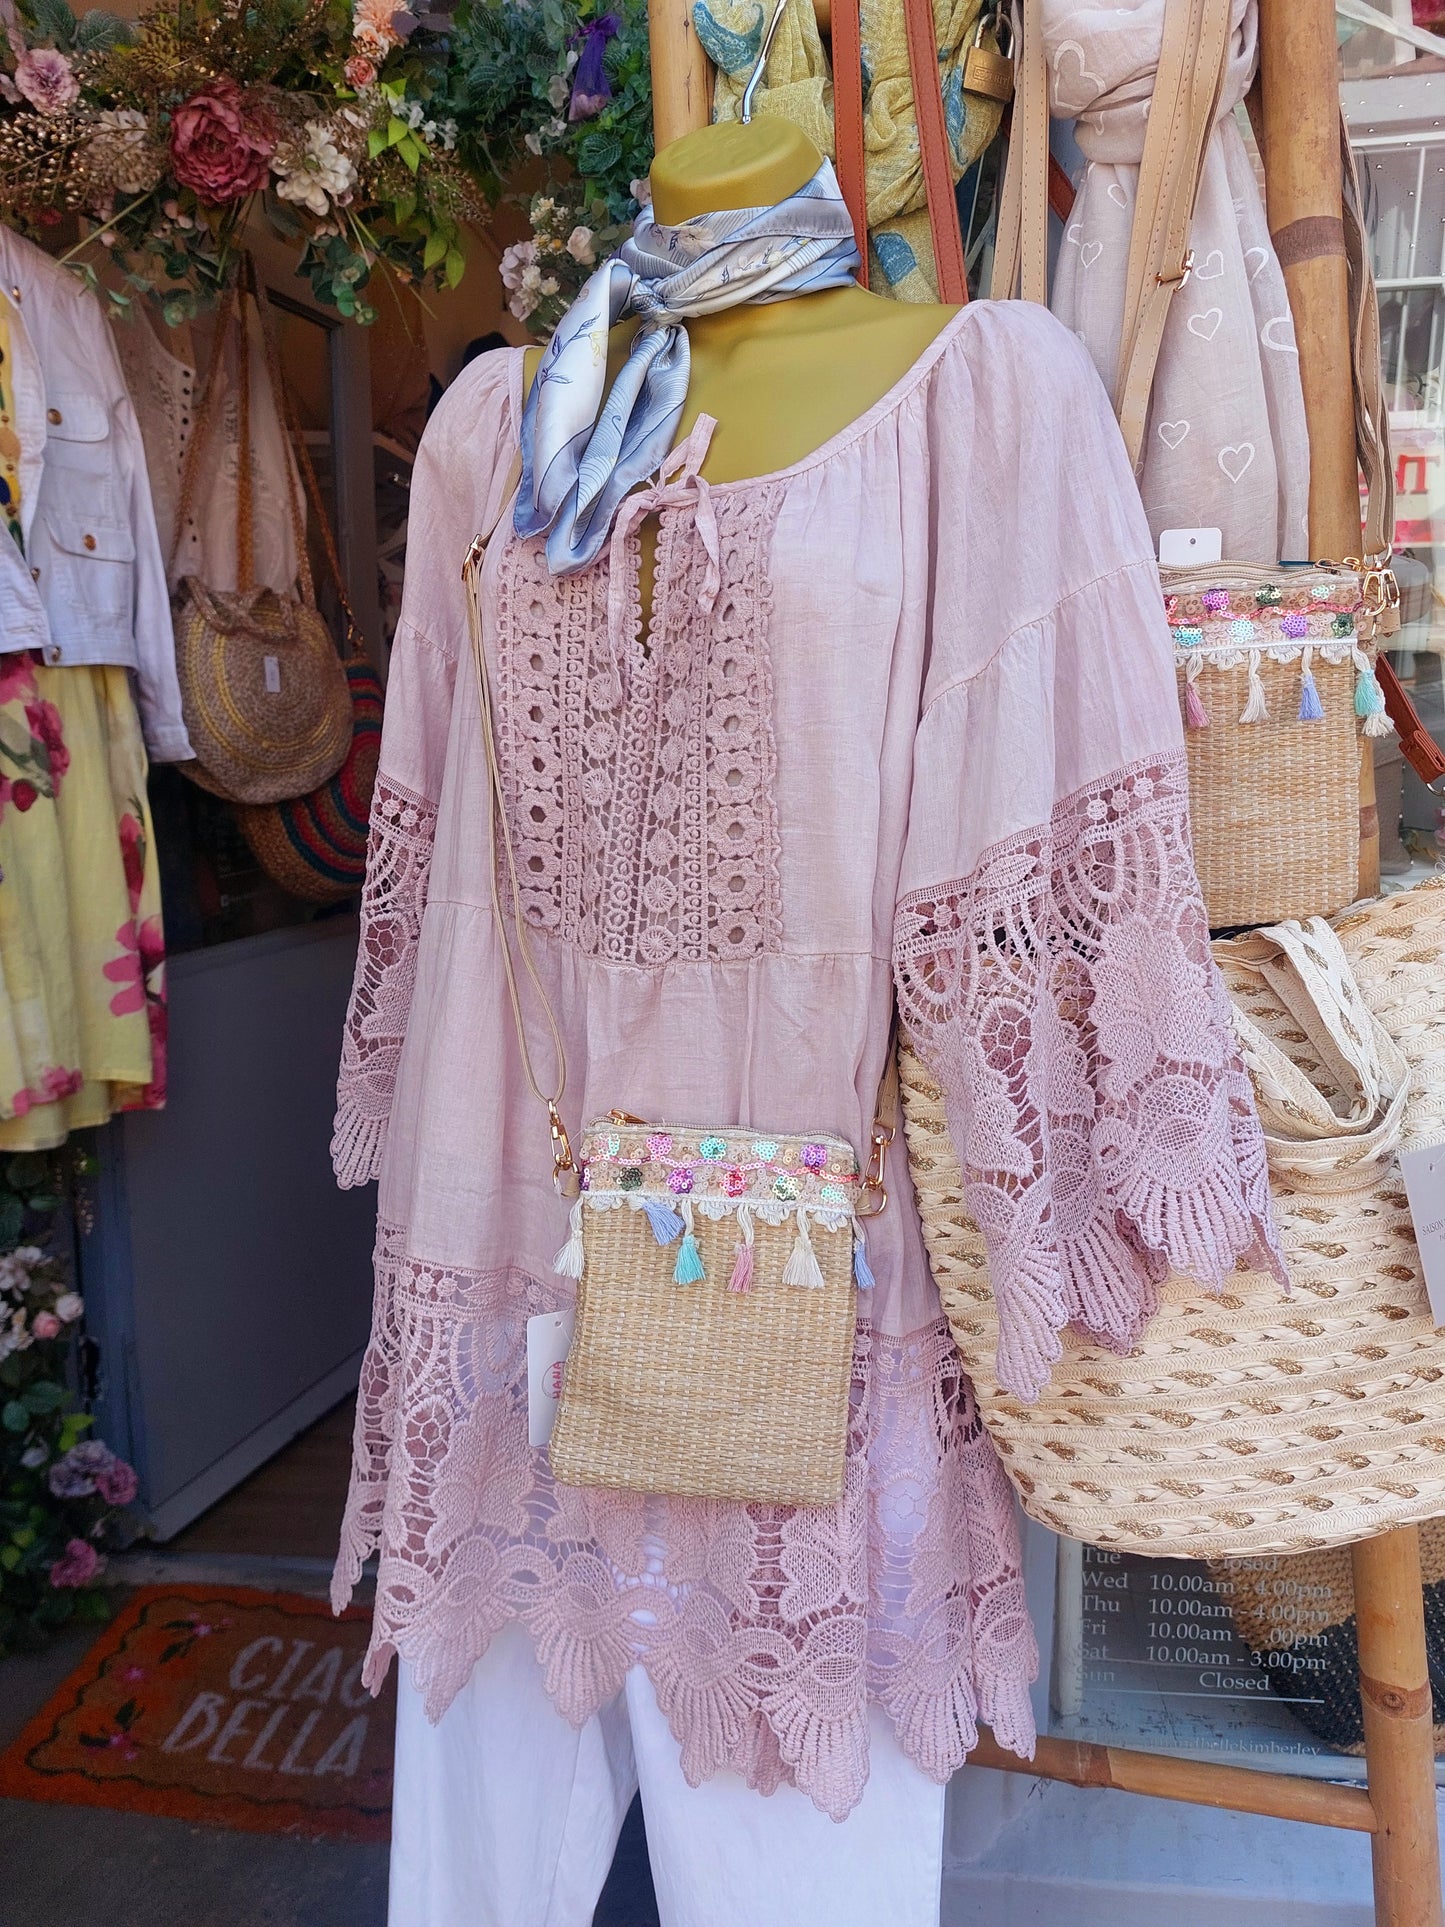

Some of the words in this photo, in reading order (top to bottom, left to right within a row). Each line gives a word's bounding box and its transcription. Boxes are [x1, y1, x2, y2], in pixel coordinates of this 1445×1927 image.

[1083, 1546, 1121, 1565] Tue
[1081, 1570, 1129, 1589] Wed
[1149, 1574, 1236, 1594] 10.00am
[1254, 1577, 1333, 1602] 4.00pm
[1082, 1594, 1121, 1613] Thu
[1148, 1598, 1234, 1618] 10.00am
[1252, 1603, 1330, 1625] 4.00pm
[1080, 1617, 1107, 1636] Fri
[1147, 1621, 1233, 1642] 10.00am
[1252, 1626, 1329, 1650] .00pm
[1077, 1642, 1110, 1659] Sat
[1146, 1645, 1231, 1666] 10.00am
[1249, 1650, 1327, 1674] 3.00pm
[1199, 1671, 1271, 1691] Closed
[160, 1691, 371, 1777] BELLA
